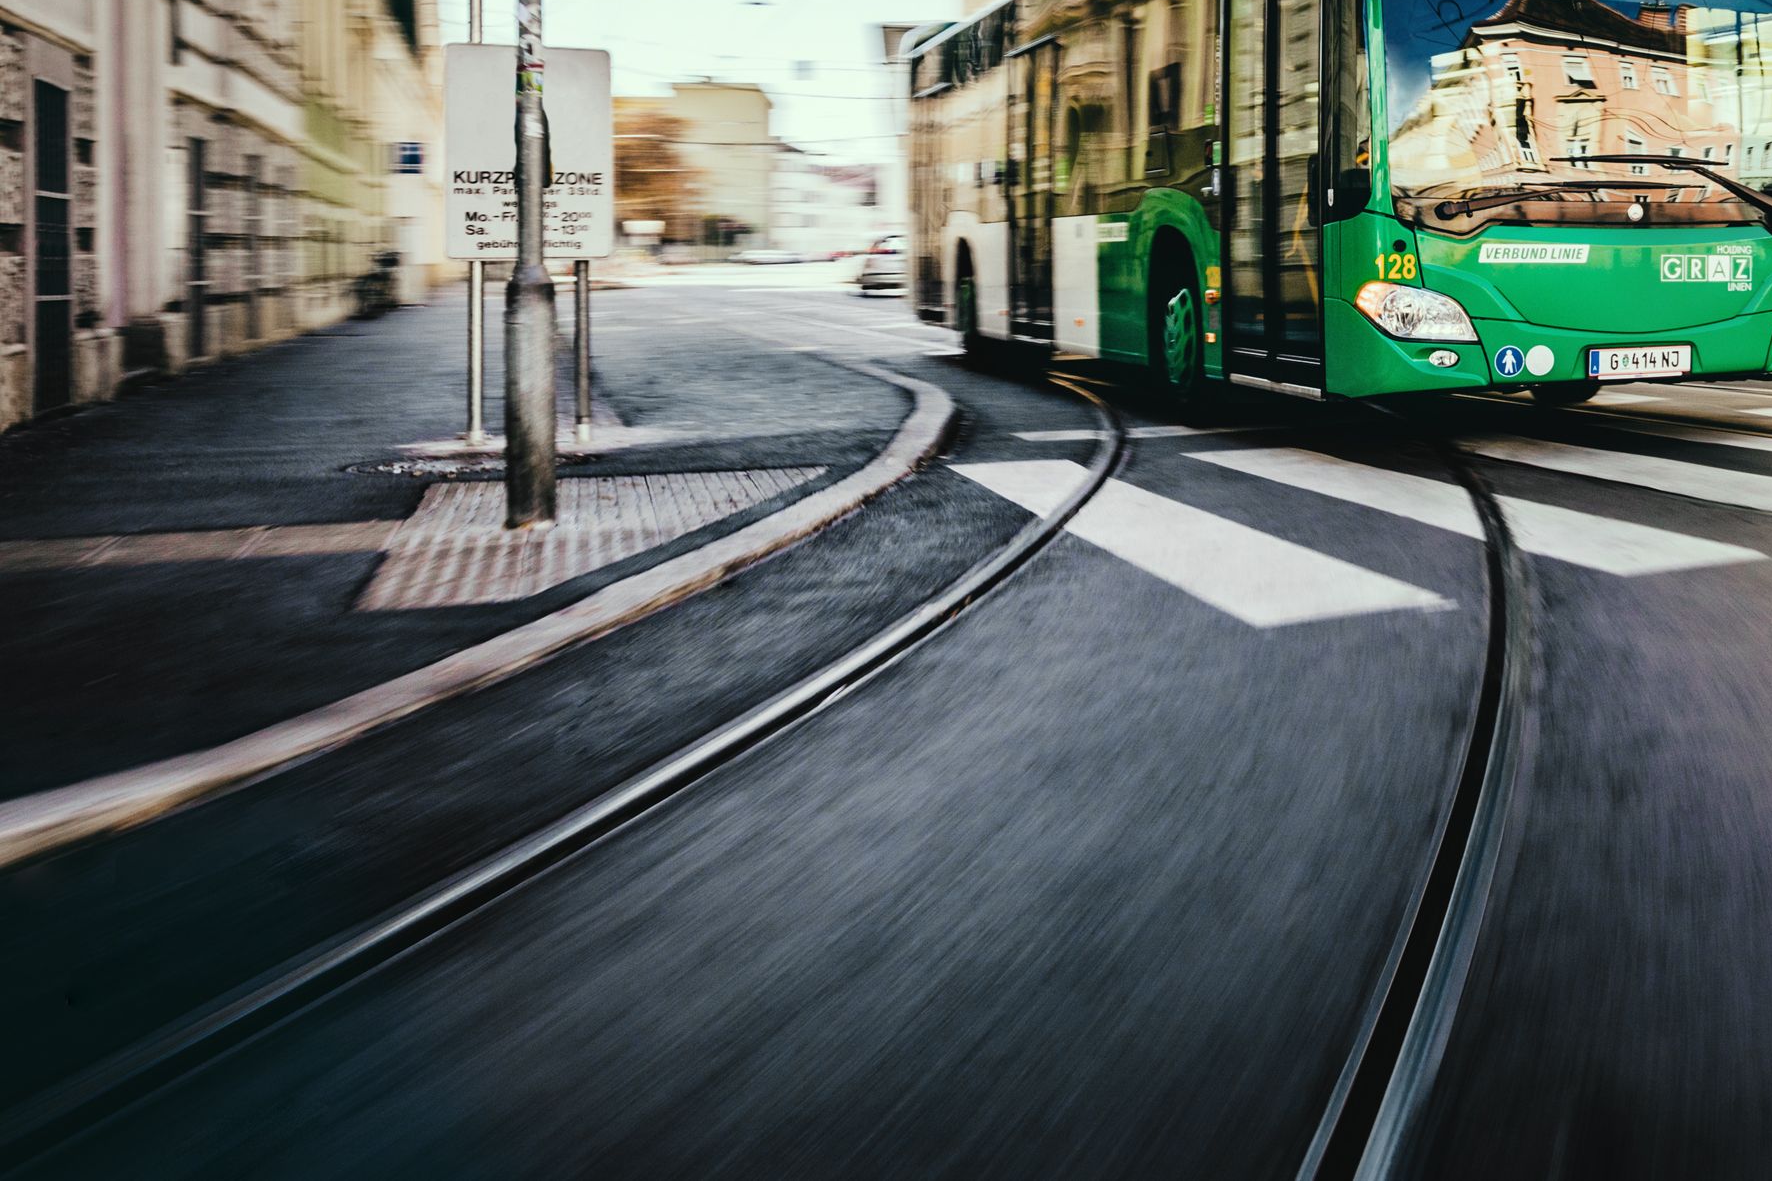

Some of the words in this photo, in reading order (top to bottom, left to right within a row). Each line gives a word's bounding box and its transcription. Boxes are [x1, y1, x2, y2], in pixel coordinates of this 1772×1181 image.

[453, 170, 603, 185] KURZPZONE
[453, 187, 486, 195] max.
[465, 224, 489, 236] Sa.
[1485, 247, 1548, 260] VERBUND
[1550, 247, 1585, 260] LINIE
[1716, 245, 1753, 255] HOLDING
[1375, 253, 1417, 280] 128
[1663, 257, 1750, 280] GRAZ
[1727, 282, 1752, 292] LINIEN
[1610, 353, 1619, 370] G
[1631, 352, 1657, 369] 414
[1661, 351, 1680, 368] NJ
